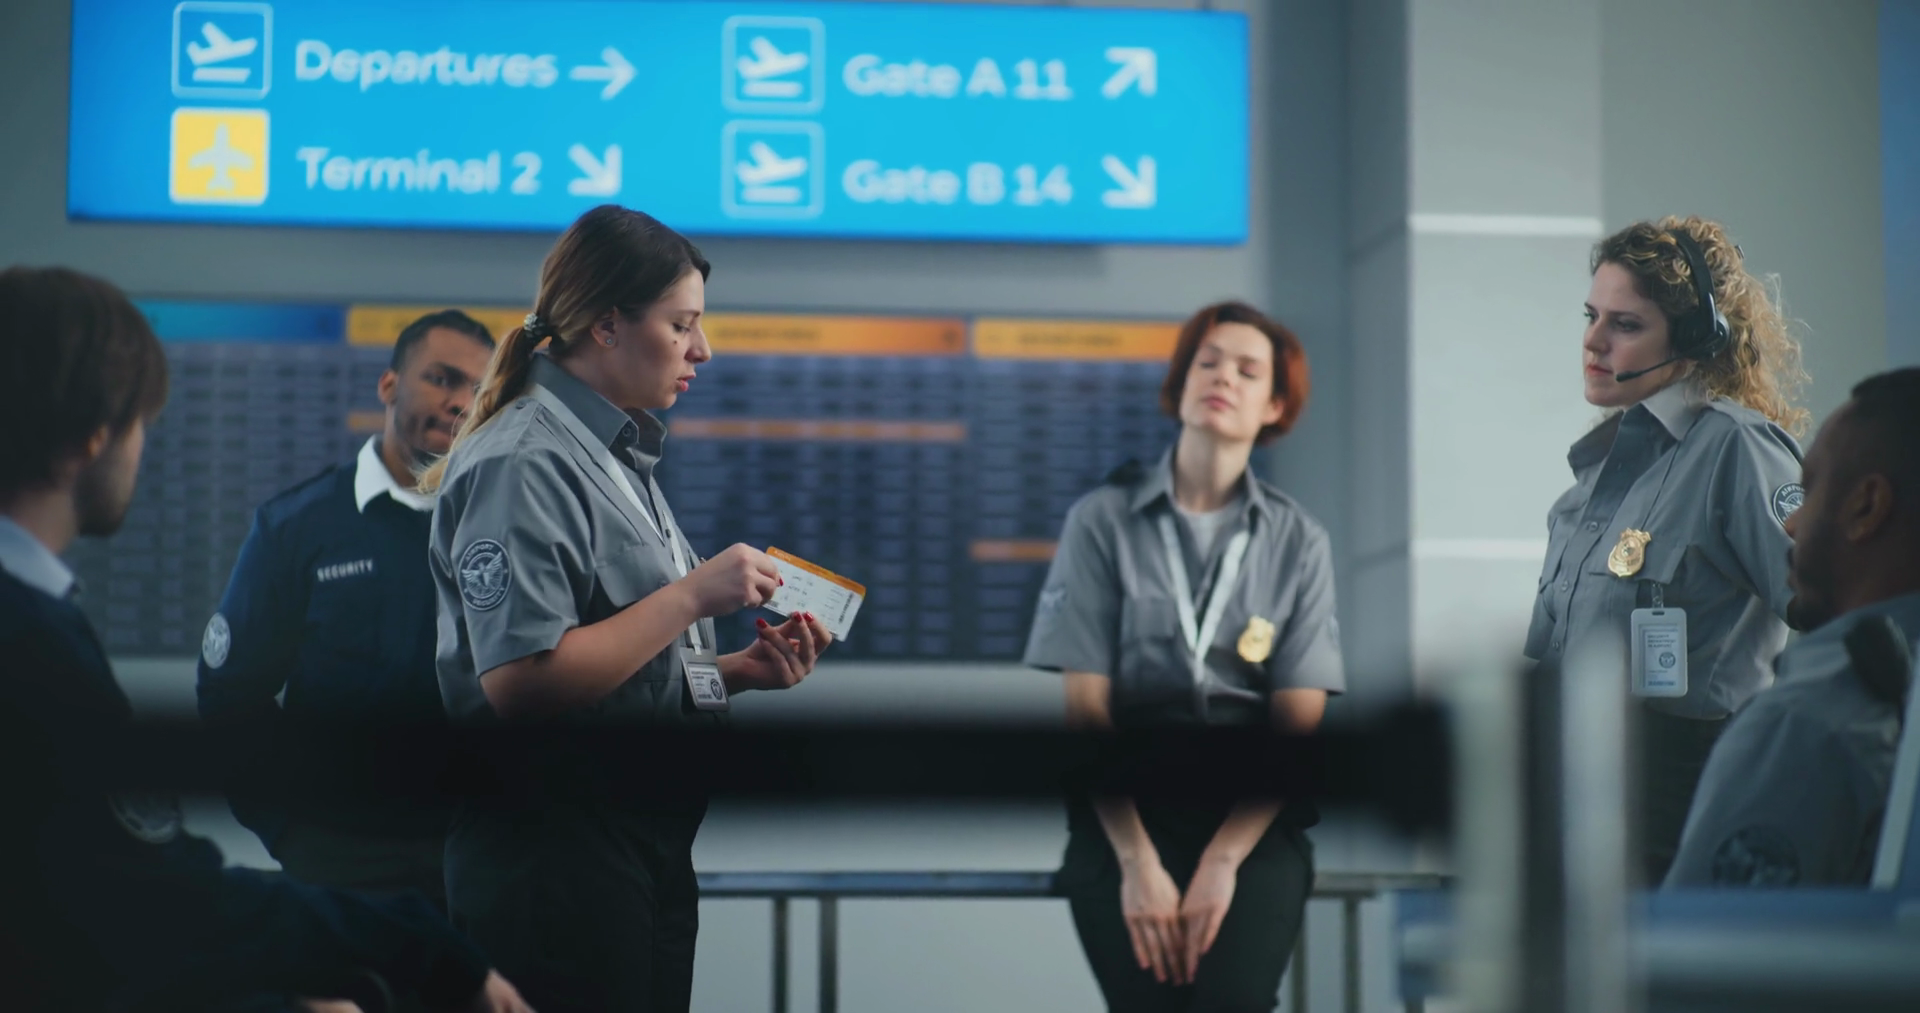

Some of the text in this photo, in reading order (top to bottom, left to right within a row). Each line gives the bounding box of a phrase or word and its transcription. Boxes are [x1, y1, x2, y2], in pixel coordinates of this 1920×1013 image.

[295, 39, 558, 92] Departures
[842, 54, 1073, 100] Gate A 11
[298, 147, 542, 195] Terminal 2
[842, 159, 1073, 206] Gate B 14
[1781, 485, 1805, 497] AIRPO
[317, 558, 373, 582] SECURITY
